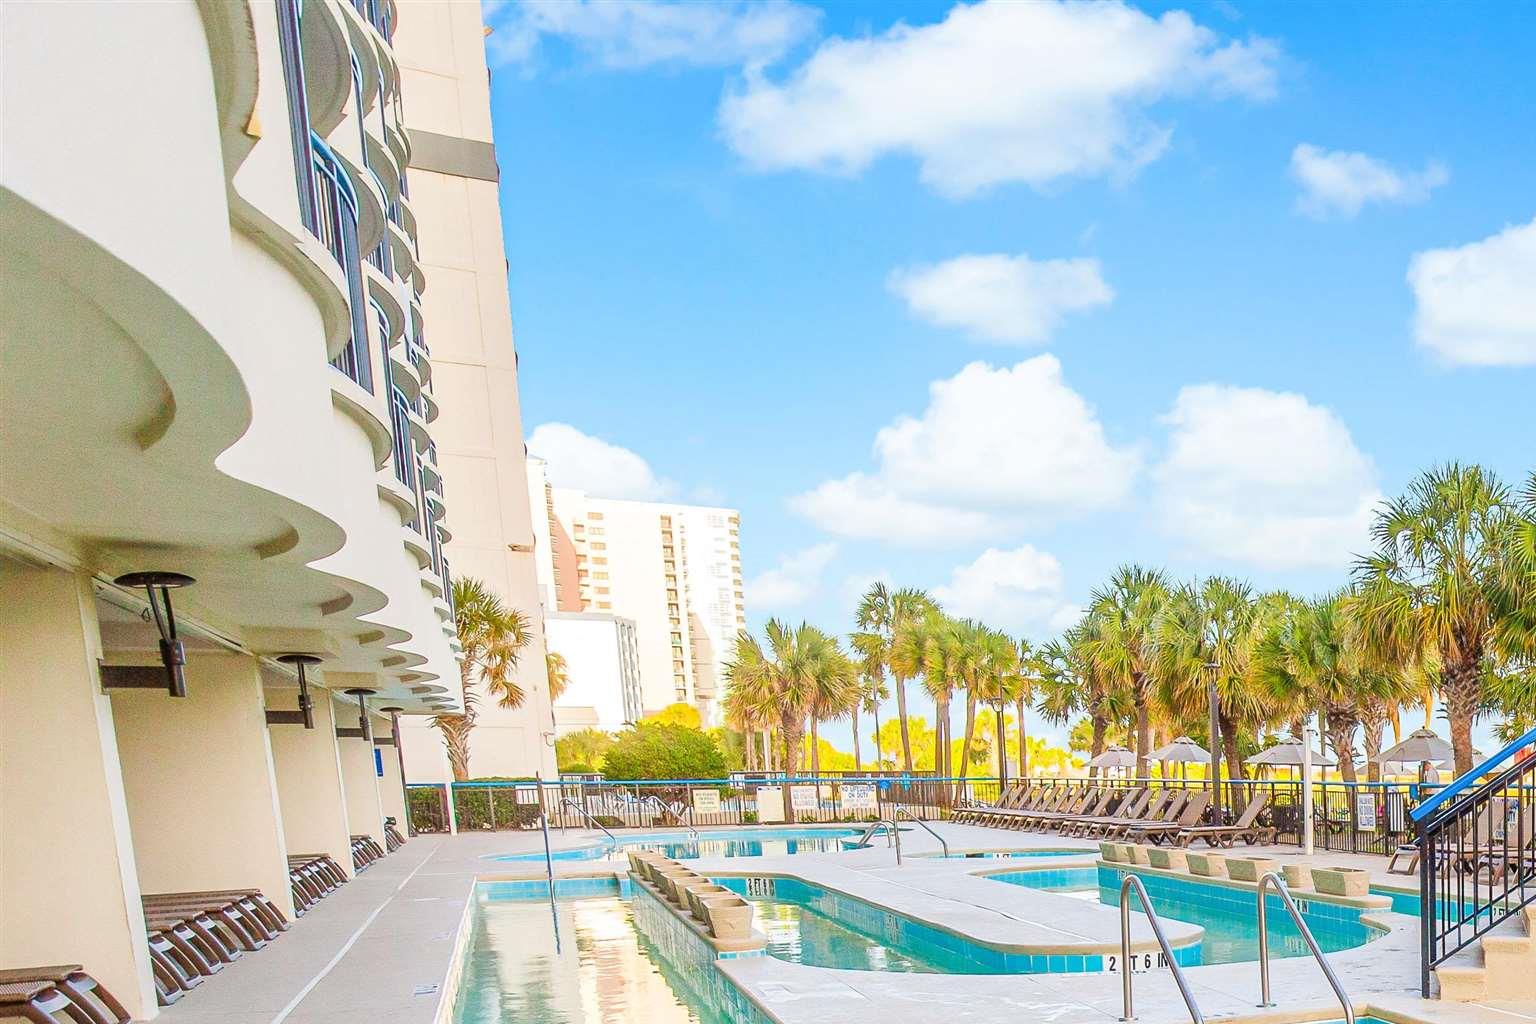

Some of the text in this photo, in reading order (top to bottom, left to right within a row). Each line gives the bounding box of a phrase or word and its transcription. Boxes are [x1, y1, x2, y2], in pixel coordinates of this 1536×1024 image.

[1109, 956, 1117, 971] 2
[1144, 953, 1151, 969] 6
[1157, 952, 1168, 968] IN
